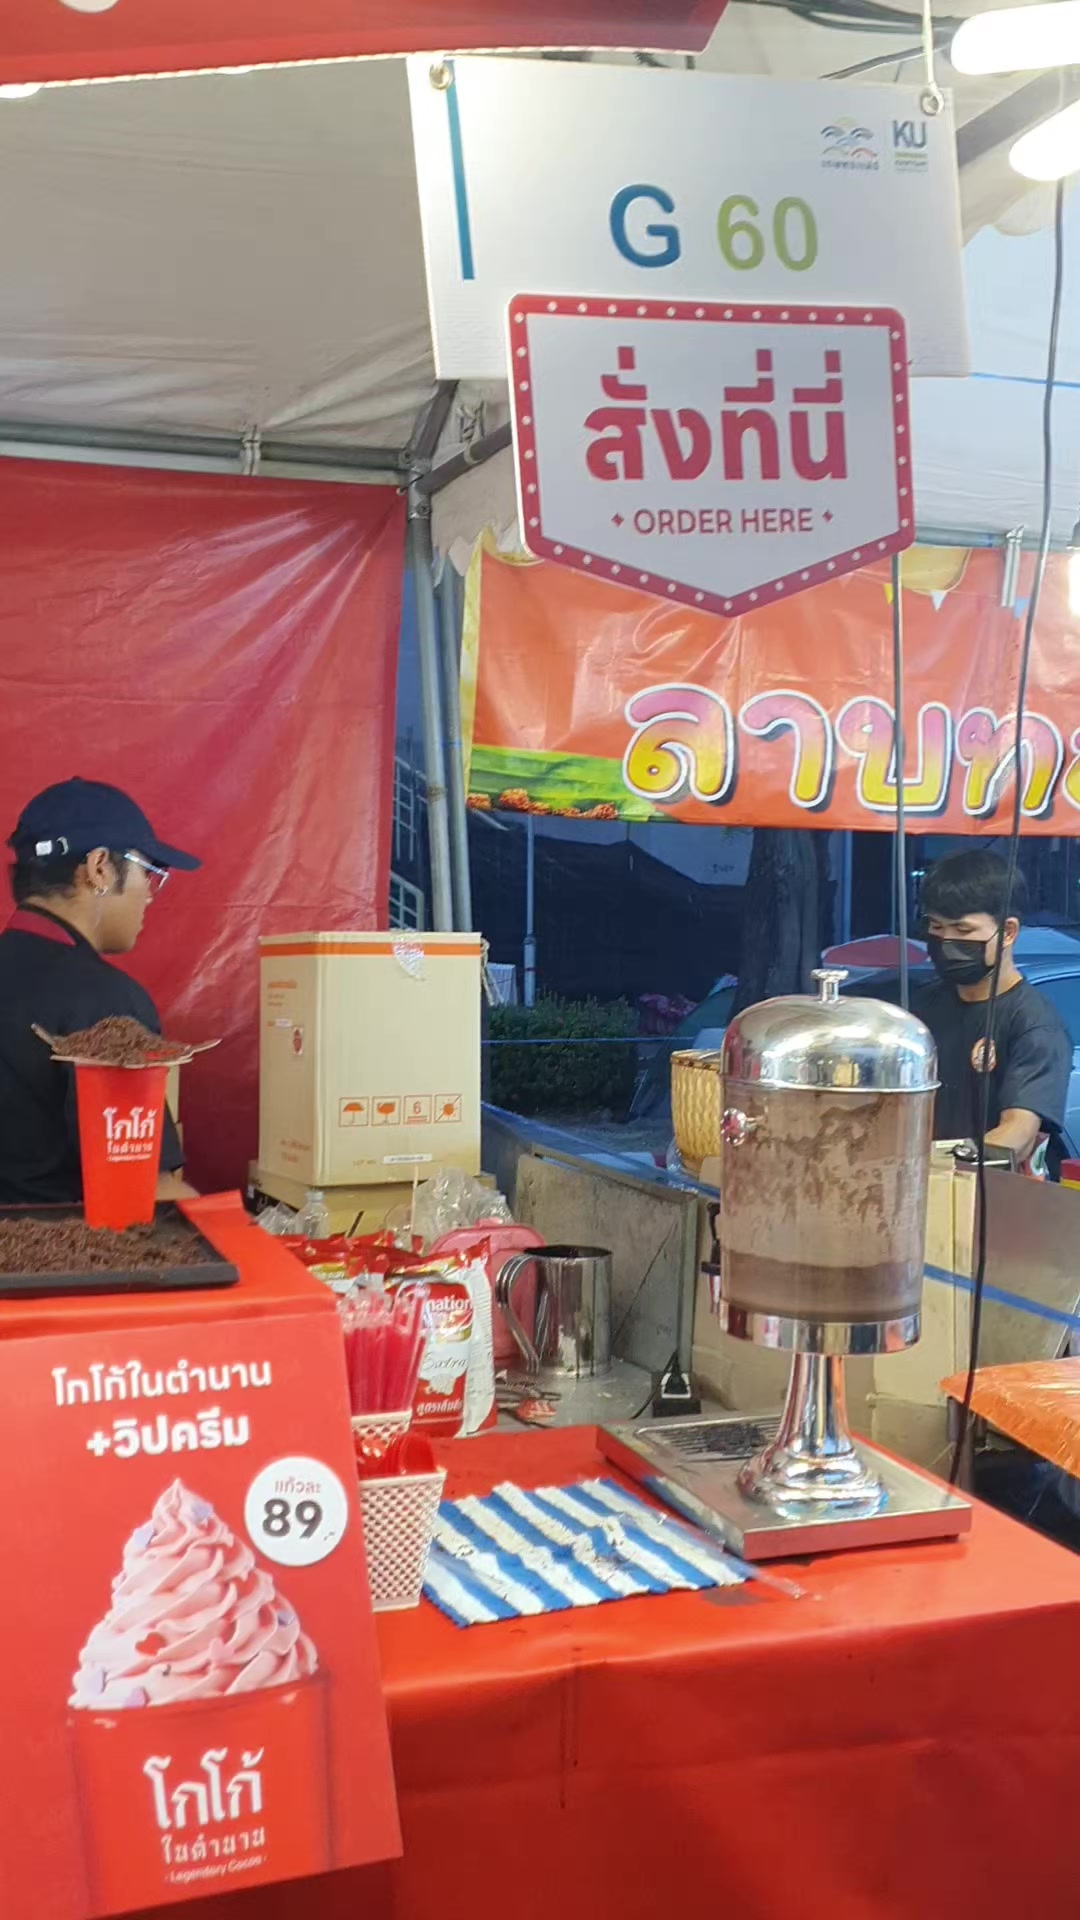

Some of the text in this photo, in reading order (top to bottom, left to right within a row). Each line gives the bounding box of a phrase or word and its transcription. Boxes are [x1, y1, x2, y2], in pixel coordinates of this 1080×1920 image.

[893, 119, 927, 148] KU
[609, 183, 818, 272] G 60
[584, 346, 848, 481] สั่งที่นี่
[633, 508, 813, 534] ORDER HERE
[622, 682, 1080, 817] ลาบท
[102, 1106, 157, 1140] โกโก้
[52, 1359, 272, 1405] โกโก้ในตำนาน
[275, 1476, 321, 1494] แก้วละ
[143, 1746, 265, 1829] โกโก้
[161, 1827, 266, 1865] ในตำนาน
